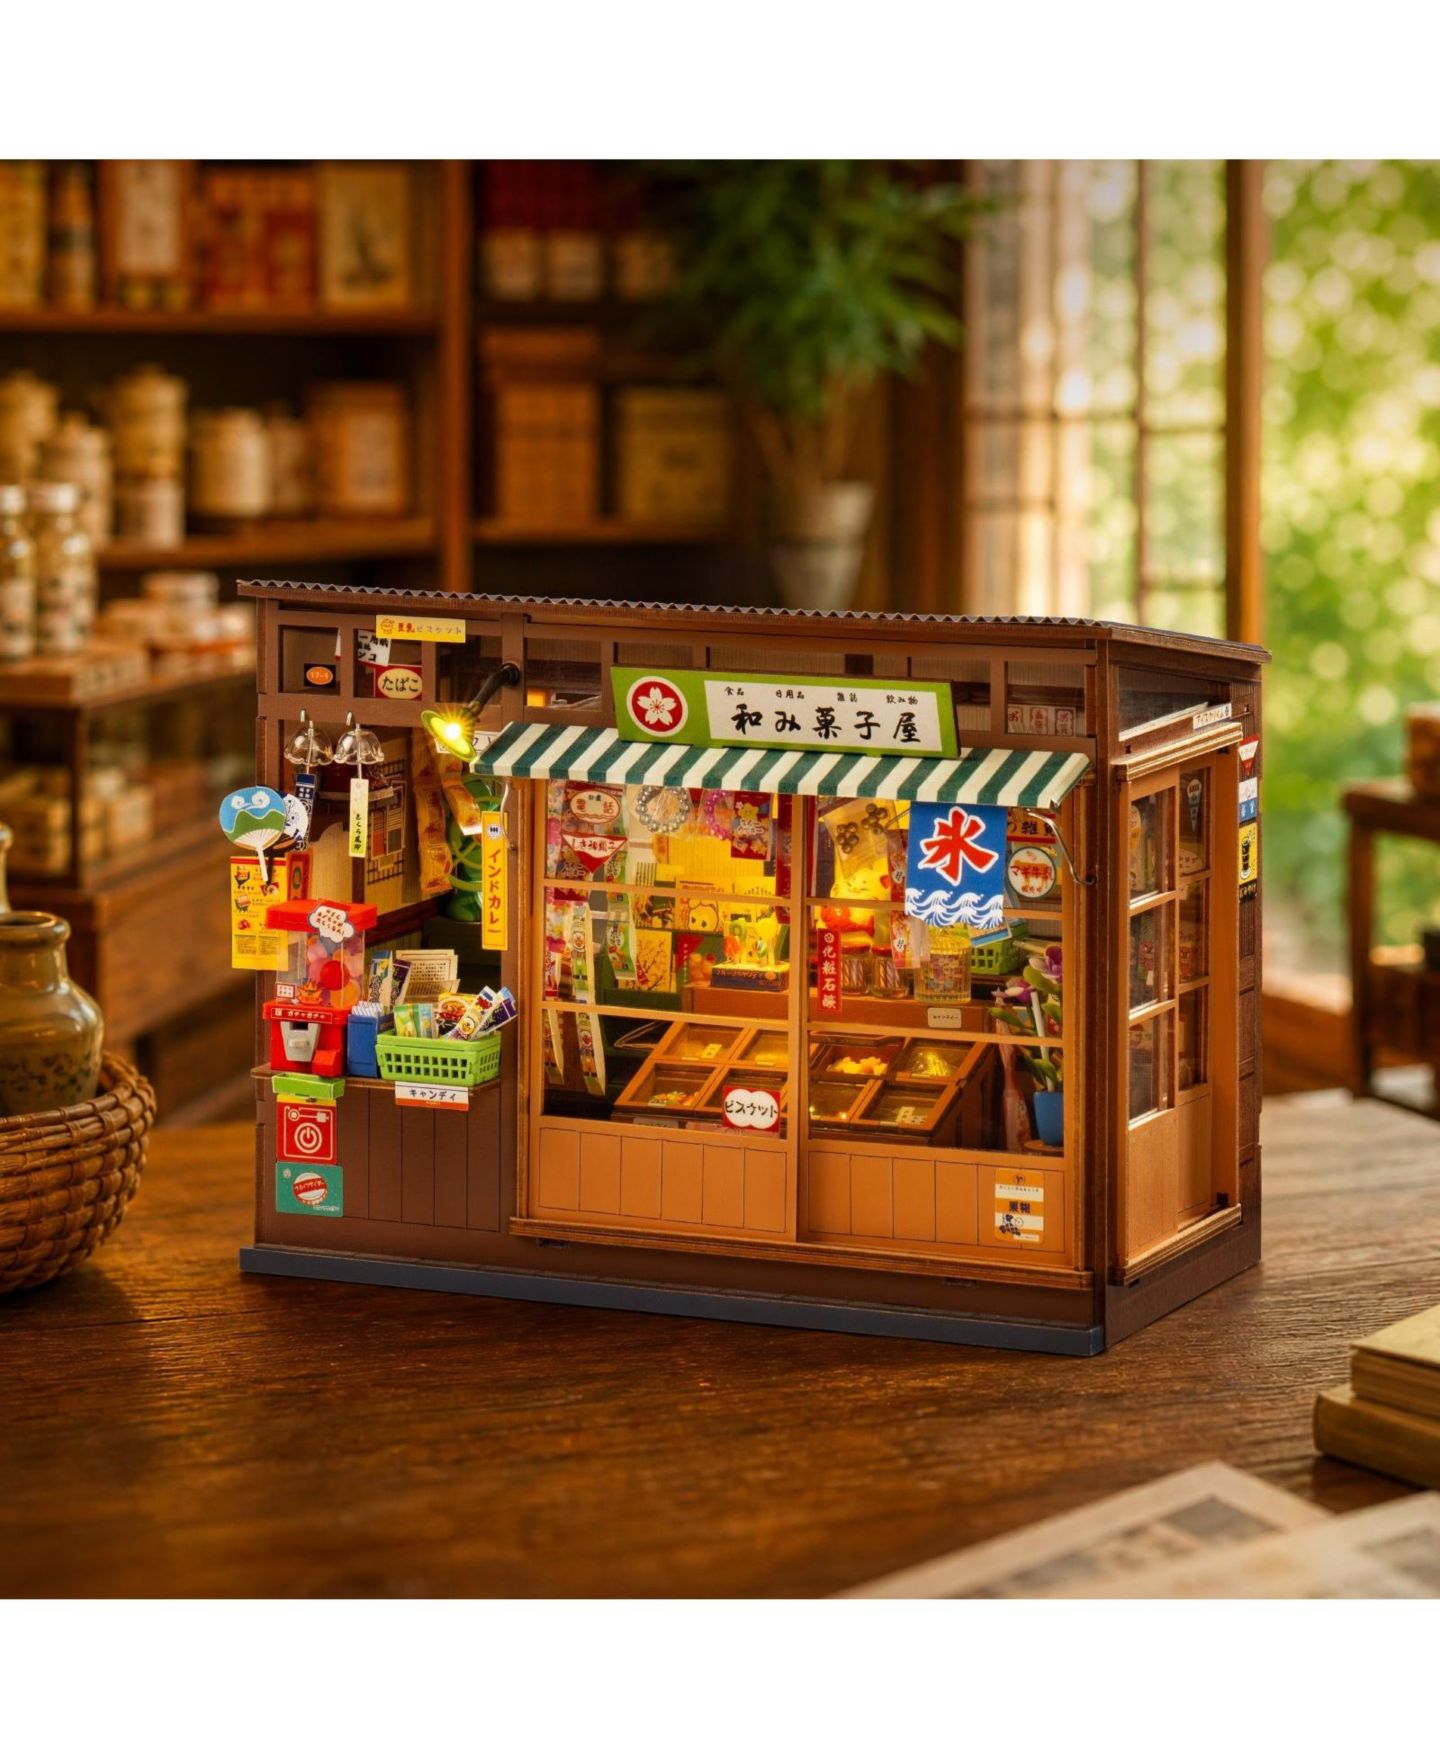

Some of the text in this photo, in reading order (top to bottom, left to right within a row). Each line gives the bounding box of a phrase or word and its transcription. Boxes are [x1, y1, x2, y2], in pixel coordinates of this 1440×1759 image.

[381, 675, 420, 693] たばこ
[724, 685, 745, 696] 食品
[775, 690, 805, 701] 日用品
[886, 694, 919, 705] 飲み物
[731, 703, 921, 743] 和み菓子屋
[921, 808, 997, 884] 氷
[488, 849, 502, 933] インドカレー
[409, 1089, 457, 1101] キャンディ
[725, 1100, 778, 1118] ビスケット
